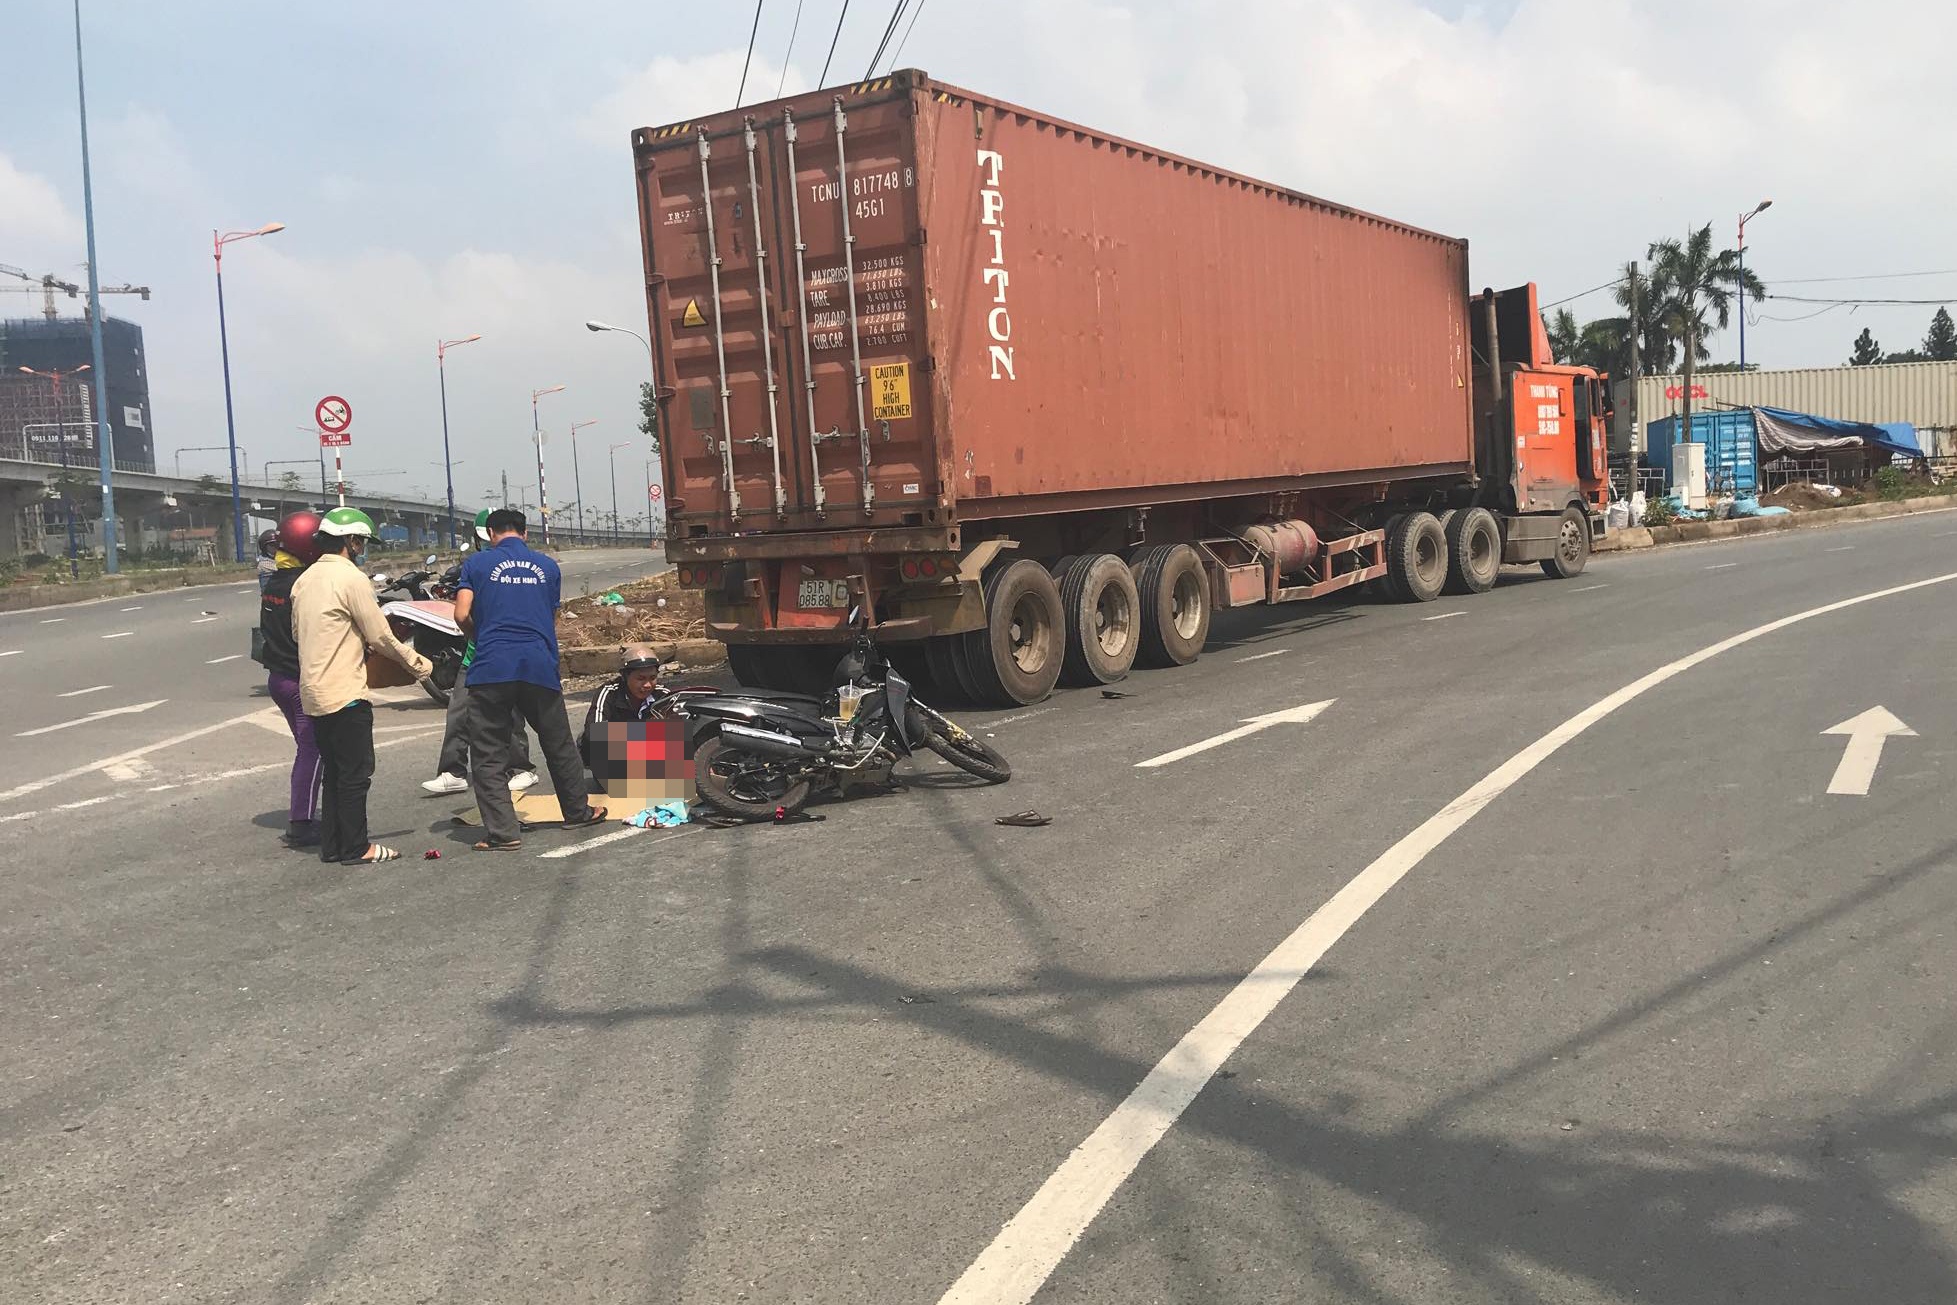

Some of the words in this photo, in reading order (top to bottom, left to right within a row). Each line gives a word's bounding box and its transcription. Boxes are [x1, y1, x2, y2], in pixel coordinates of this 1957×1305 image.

[811, 182, 840, 202] TCNU
[853, 171, 899, 196] 817748
[904, 167, 914, 187] 8
[855, 198, 884, 218] 45G1
[862, 259, 888, 271] 32.500
[890, 256, 904, 266] KGS
[976, 150, 1015, 380] TRITON
[889, 268, 903, 277] LBS
[810, 290, 831, 307] TARE
[865, 281, 886, 292] 3.810
[889, 278, 902, 288] KGS
[891, 289, 905, 300] LBS
[813, 310, 847, 330] PAYLOAD
[865, 302, 891, 314] 28.690
[893, 300, 907, 311] KGS
[892, 311, 906, 321] LBS
[892, 322, 905, 332] CUM
[875, 365, 904, 379] CAUTION
[882, 392, 900, 405] HIGH
[874, 404, 911, 419] CONTAINER
[490, 566, 502, 581] GIAO
[516, 560, 531, 569] NAM
[806, 581, 824, 594] 51R
